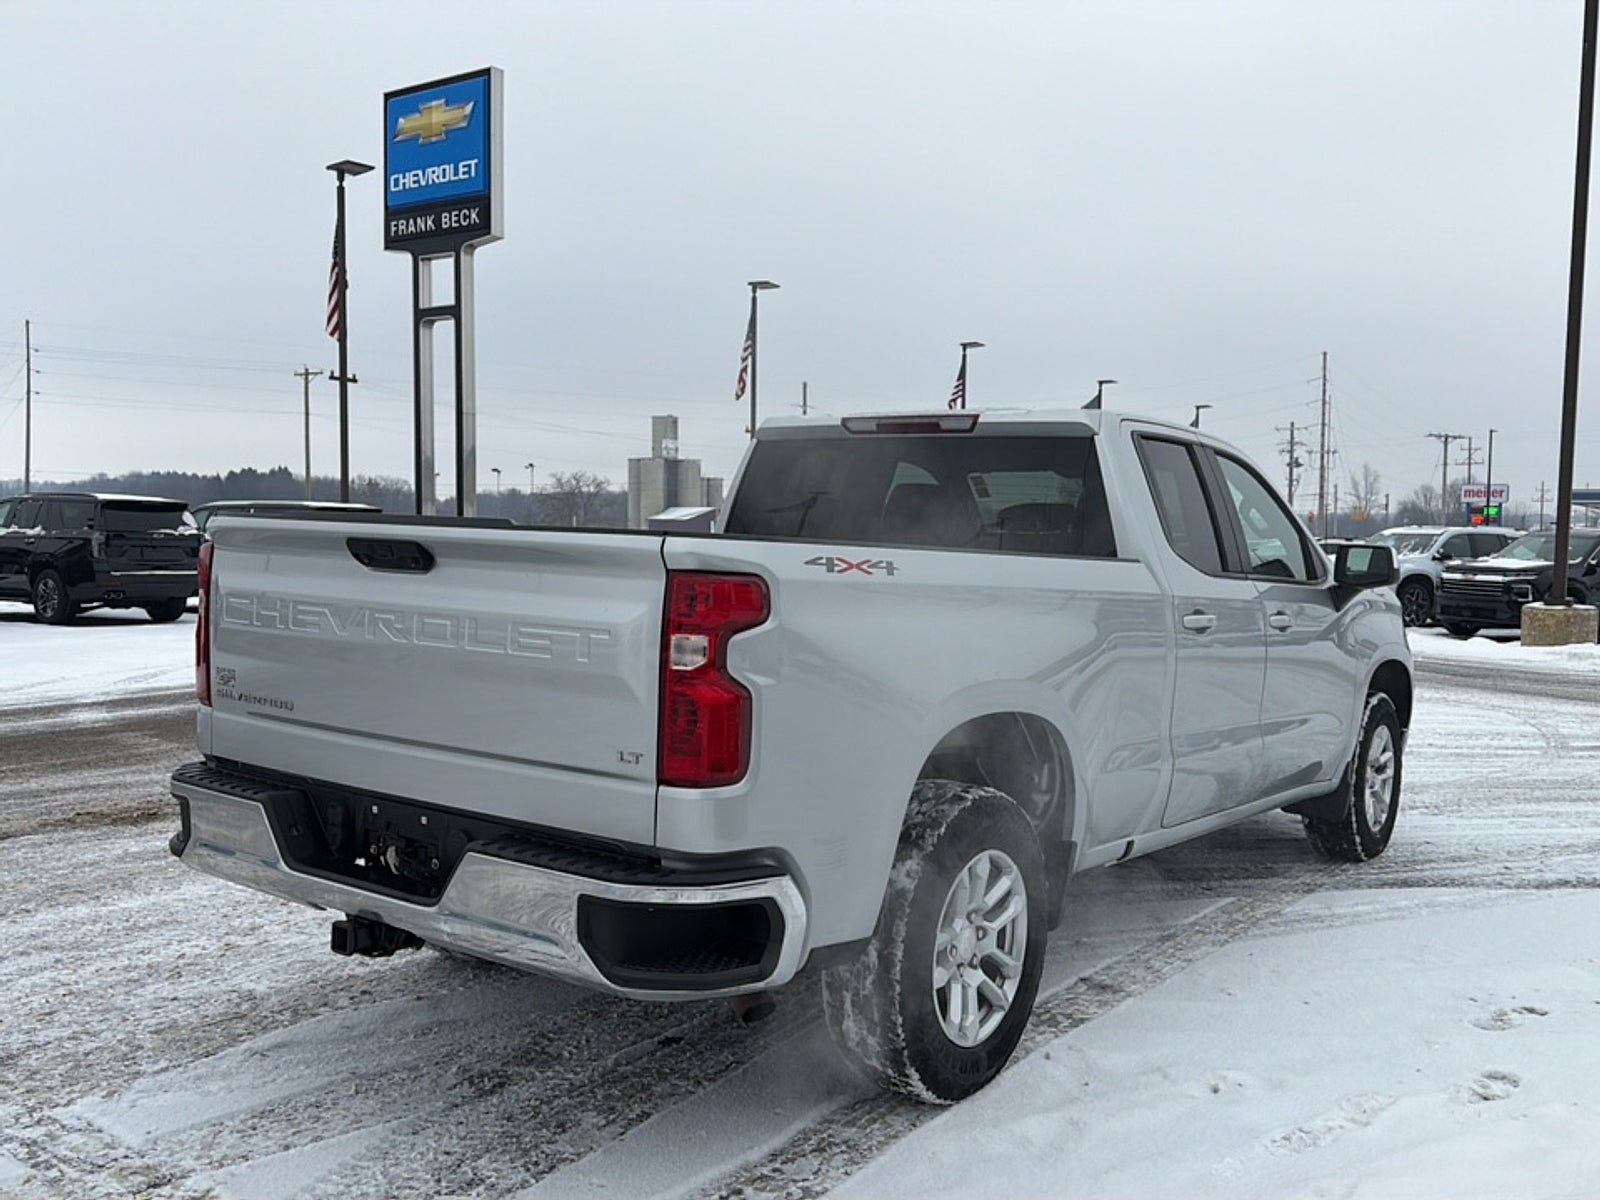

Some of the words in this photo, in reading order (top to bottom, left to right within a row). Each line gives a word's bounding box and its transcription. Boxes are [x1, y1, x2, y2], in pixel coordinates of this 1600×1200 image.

[390, 159, 478, 191] CHEVROLET
[390, 214, 436, 237] FRANK
[441, 207, 480, 229] BECK
[1463, 487, 1504, 498] meier
[221, 594, 612, 663] CHEVROLET
[616, 749, 645, 766] LT
